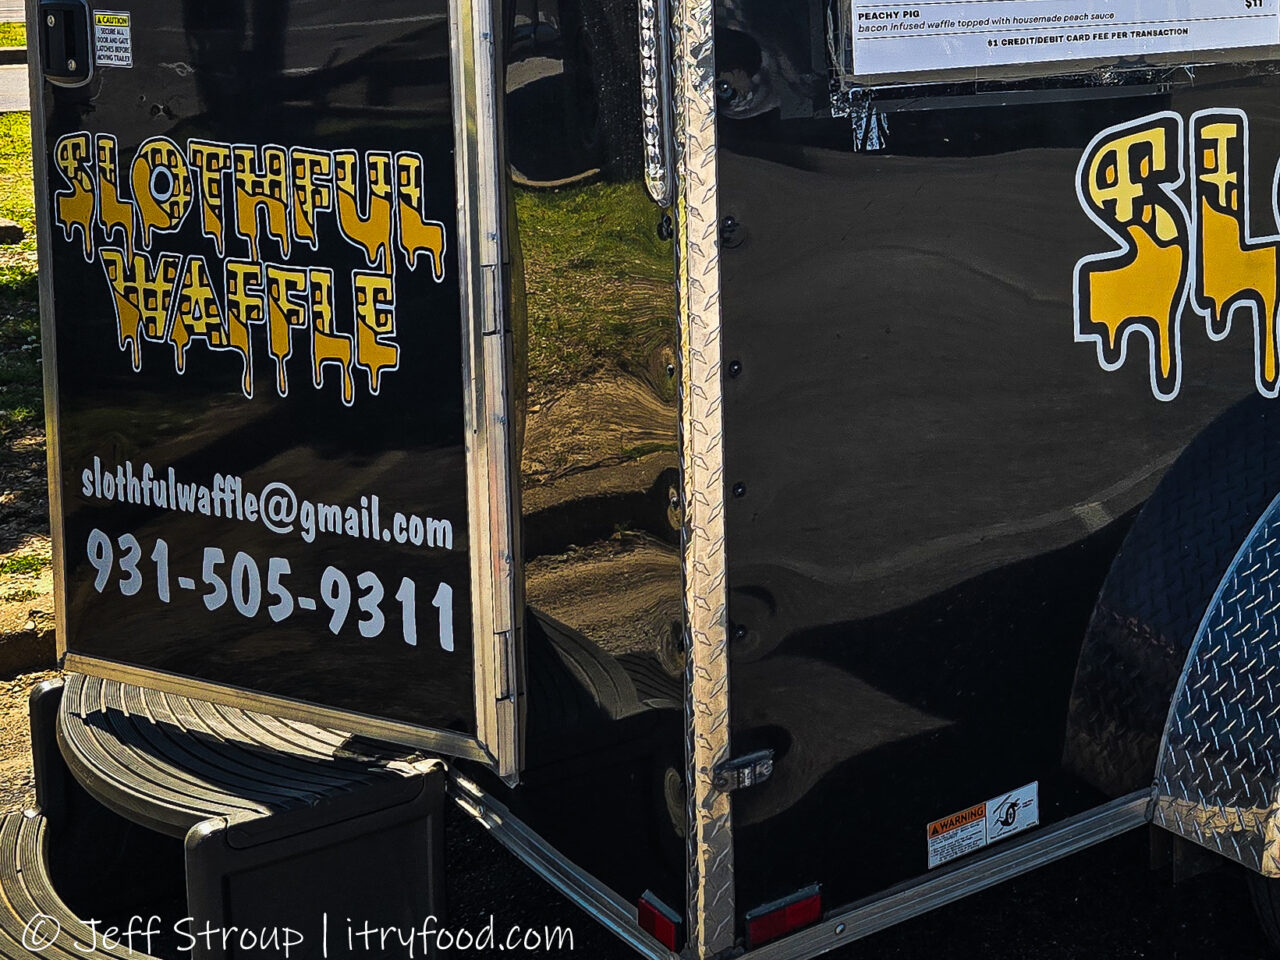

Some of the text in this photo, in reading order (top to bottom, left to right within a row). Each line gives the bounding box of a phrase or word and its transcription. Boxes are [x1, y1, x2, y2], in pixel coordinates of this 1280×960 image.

[102, 16, 127, 25] CAUTION
[857, 9, 920, 21] PEACHY PIG
[1000, 34, 1065, 47] CREDIT/DEBIT
[1065, 33, 1091, 43] CARD
[1092, 31, 1110, 41] FEE
[1110, 30, 1128, 40] PER
[1129, 27, 1189, 39] TRANSACTION
[54, 130, 446, 282] SLOTHFUL
[98, 246, 400, 407] WAFFLE
[81, 455, 454, 550] slothfulwaffle@gmail.com
[86, 528, 455, 652] 931-505-9311
[939, 806, 984, 831] WARNING
